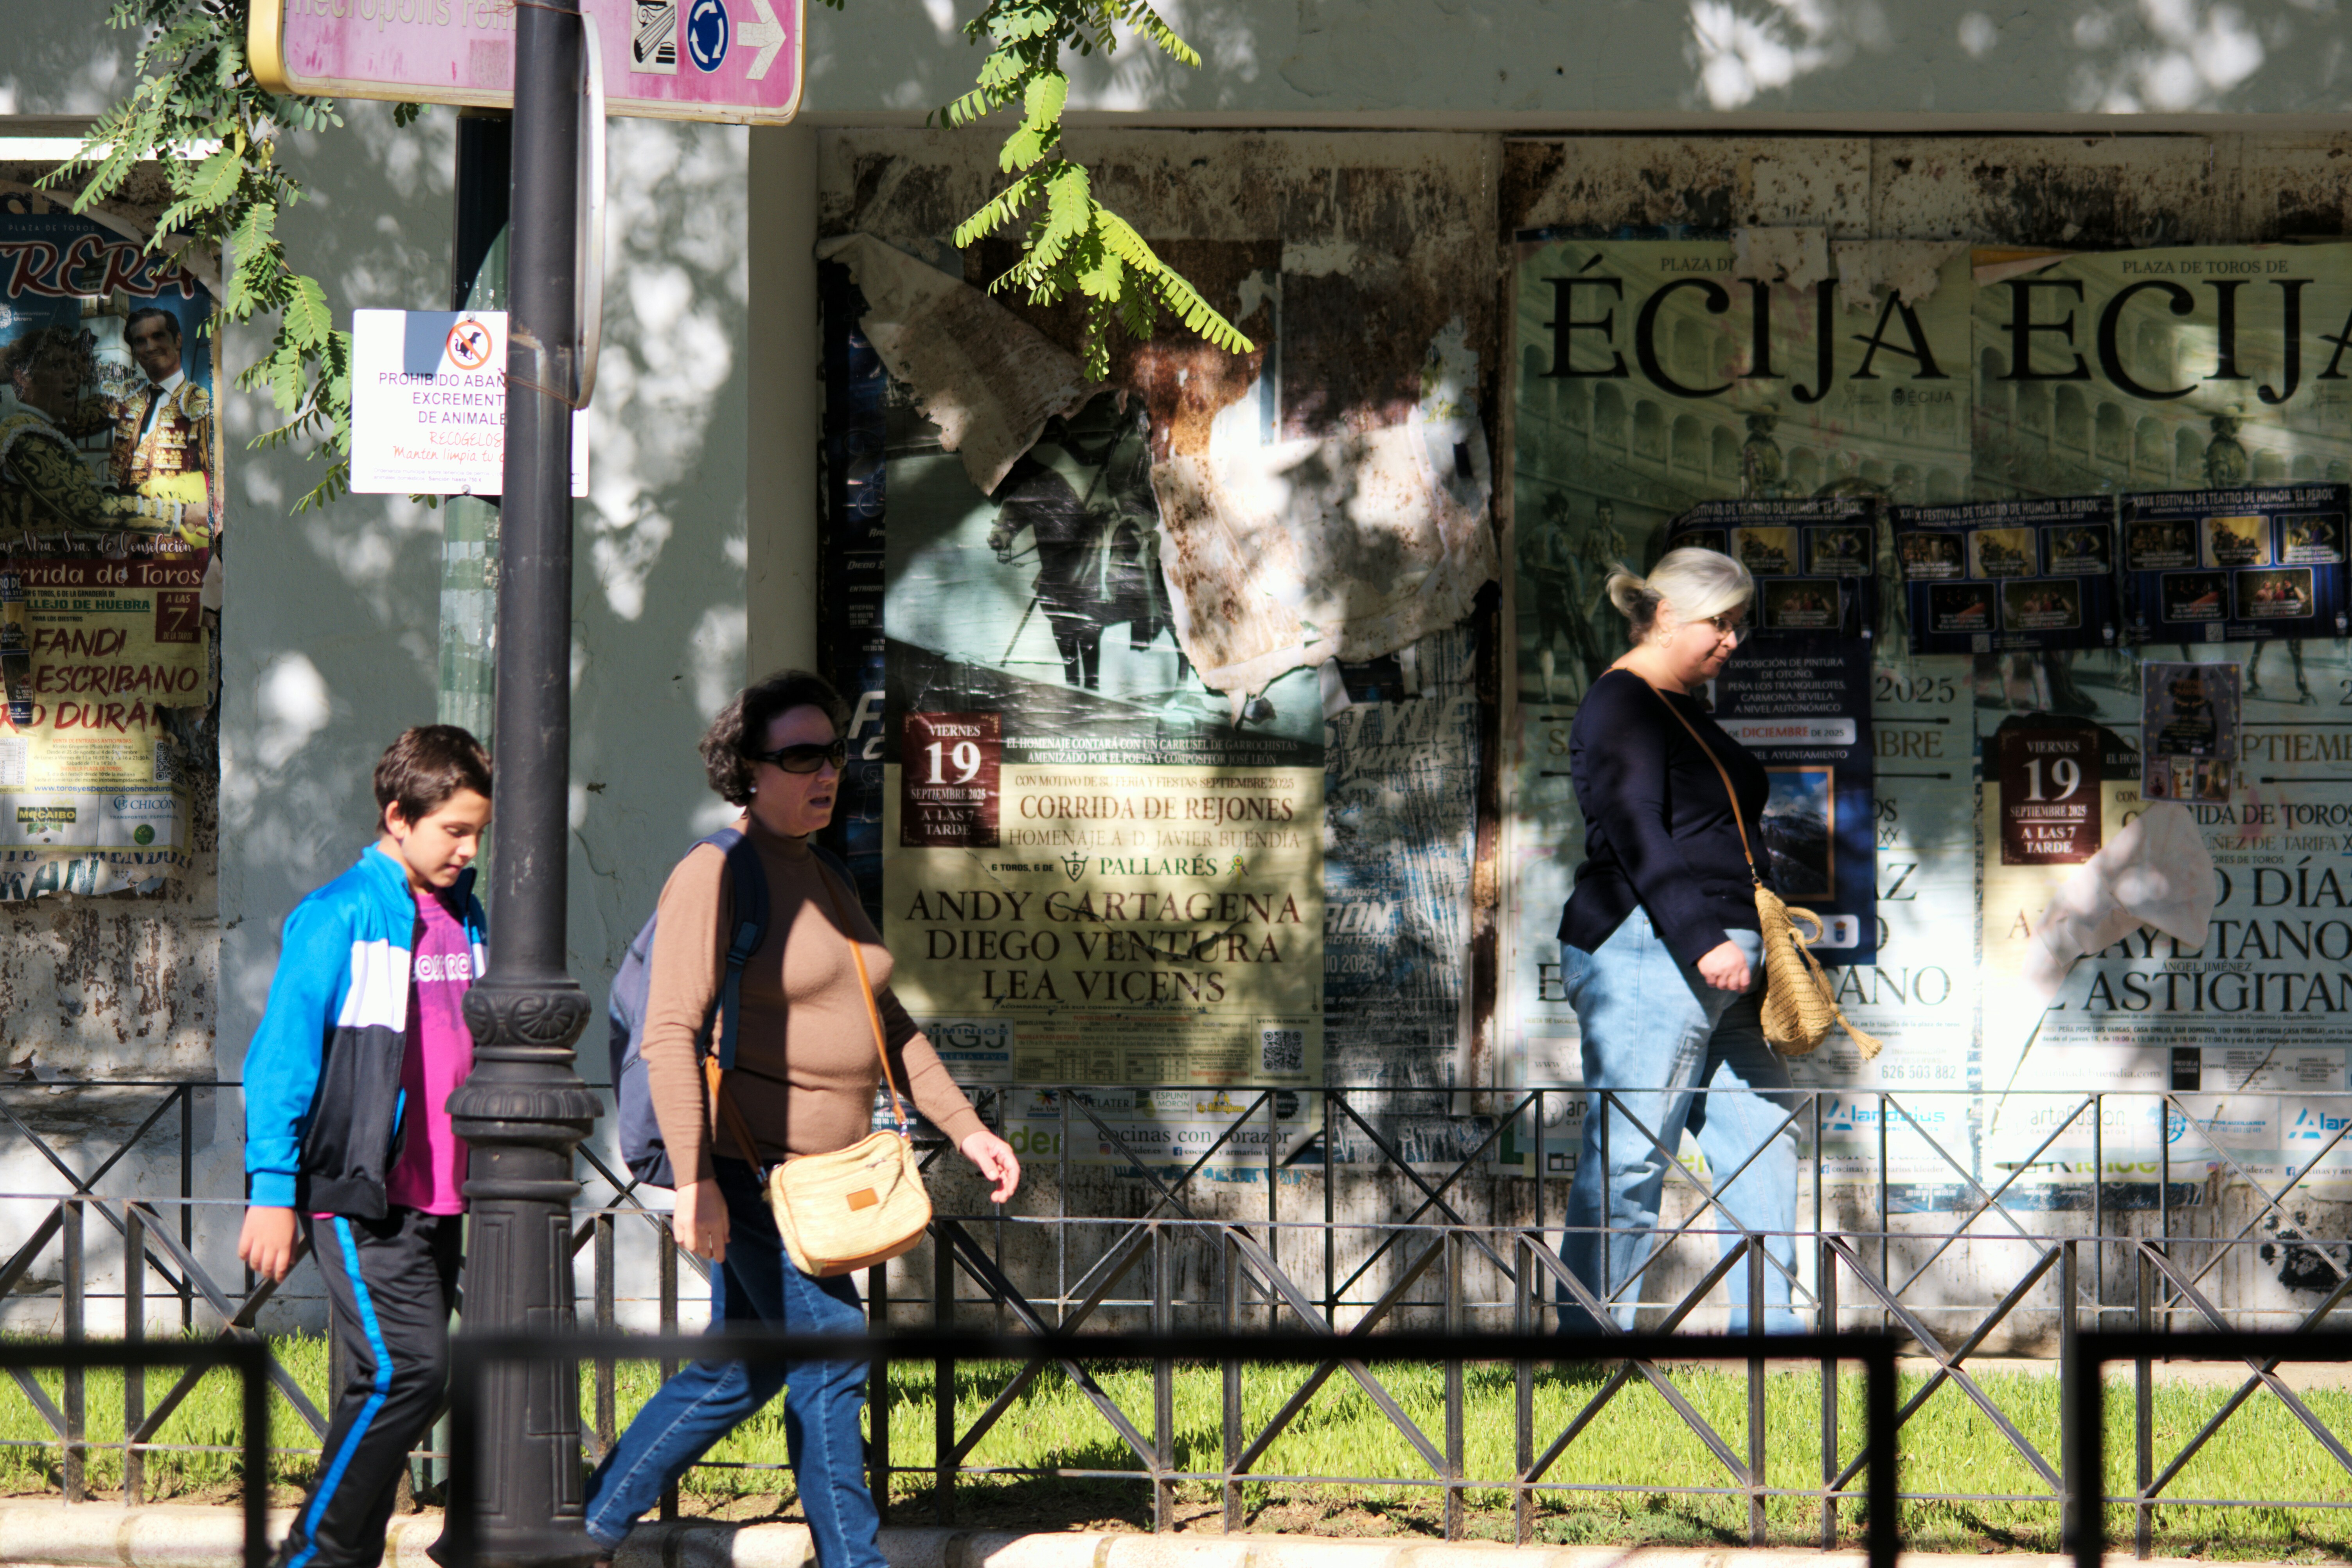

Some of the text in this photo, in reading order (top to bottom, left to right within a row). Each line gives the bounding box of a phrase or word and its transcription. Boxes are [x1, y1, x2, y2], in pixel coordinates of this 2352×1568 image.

[1660, 259, 1711, 271] PLAZA
[2122, 261, 2288, 274] PLAZA DE TOROS DE
[1539, 254, 1950, 403] ÉCIJA
[379, 372, 459, 386] PROHIBIDO
[413, 392, 505, 406] EXCREMENT
[419, 411, 437, 423] DE
[393, 446, 477, 464] Mantén limpia
[2156, 489, 2290, 507] FESTIVAL TEATRO HUMOR
[1739, 503, 1818, 514] TEATRO HUMOR
[1923, 502, 2055, 520] FESTIVAL TEATRO HUMOR
[23, 530, 194, 554] Ntra. Sra. de Consolación
[848, 561, 876, 569] DIEGO
[97, 563, 201, 585] de Toros
[38, 590, 107, 598] TOROS, GANADERÍA
[175, 594, 191, 603] LAS
[73, 600, 150, 610] DE HUEBRA
[167, 608, 189, 632] 7
[178, 632, 194, 640] TARDE
[32, 628, 127, 659] FANDI
[1729, 658, 1844, 668] EXPOSICIÓN DE PINTURA
[1762, 668, 1813, 679] DE OTOÑO,
[36, 665, 199, 697] ESCRIBANO
[1728, 681, 1752, 691] PEÑA
[1775, 681, 1846, 690] TRANQUILOTES,
[1875, 677, 1955, 704] 2025
[1741, 692, 1834, 703] CARMONA, SEVILLA
[1744, 703, 1841, 713] NIVEL AUTONÓMICO
[929, 725, 980, 737] VIERNES
[1742, 726, 1809, 738] DICIEMBRE
[1019, 736, 1298, 752] HOMENAJE CONTARÁ CON UN CARRUSEL GARROCHISTAS
[2027, 741, 2079, 753] VIERNES
[1028, 752, 1277, 766] AMENIZADO POETA COMPOSITOR JOSÉ LEÓN
[1771, 750, 1848, 760] AYUNTAMIENTO
[925, 741, 981, 784] 19
[1039, 776, 1294, 789] MOTIVO FIESTAS SEPTIEMBRE 2025
[2023, 758, 2081, 801] 19
[912, 788, 985, 800] SEPTIEMBRE 2025
[131, 796, 176, 809] CHICÓN
[922, 811, 964, 821] A LAS
[1020, 796, 1293, 826] CORRIDA DE REJONES
[2010, 805, 2086, 817] SEPTIEMBRE 2025
[2241, 804, 2275, 825] DE
[925, 824, 971, 835] TARDE
[2037, 827, 2065, 839] LAS
[1009, 828, 1300, 851] HOMENAJE A D. JAVIER BUENDÍA
[2252, 836, 2337, 851] DE TARIFA
[2025, 841, 2073, 853] TARDE
[1001, 853, 1217, 876] TOROS, DE PALLARÉS
[2252, 856, 2284, 864] TOROS
[2251, 855, 2352, 908] DÍA
[906, 891, 1302, 924] ANDY CARTAGENA
[926, 930, 1283, 963] DIEGO VENTURA
[1341, 955, 1376, 973] 2025
[2161, 960, 2251, 974] ÁNGEL JIMÉNEZ
[982, 969, 1225, 1003] LEA VICENS
[2059, 1025, 2075, 1033] PEÑA
[1882, 1065, 1956, 1079] 626 503 882
[1178, 1130, 1212, 1143] con
